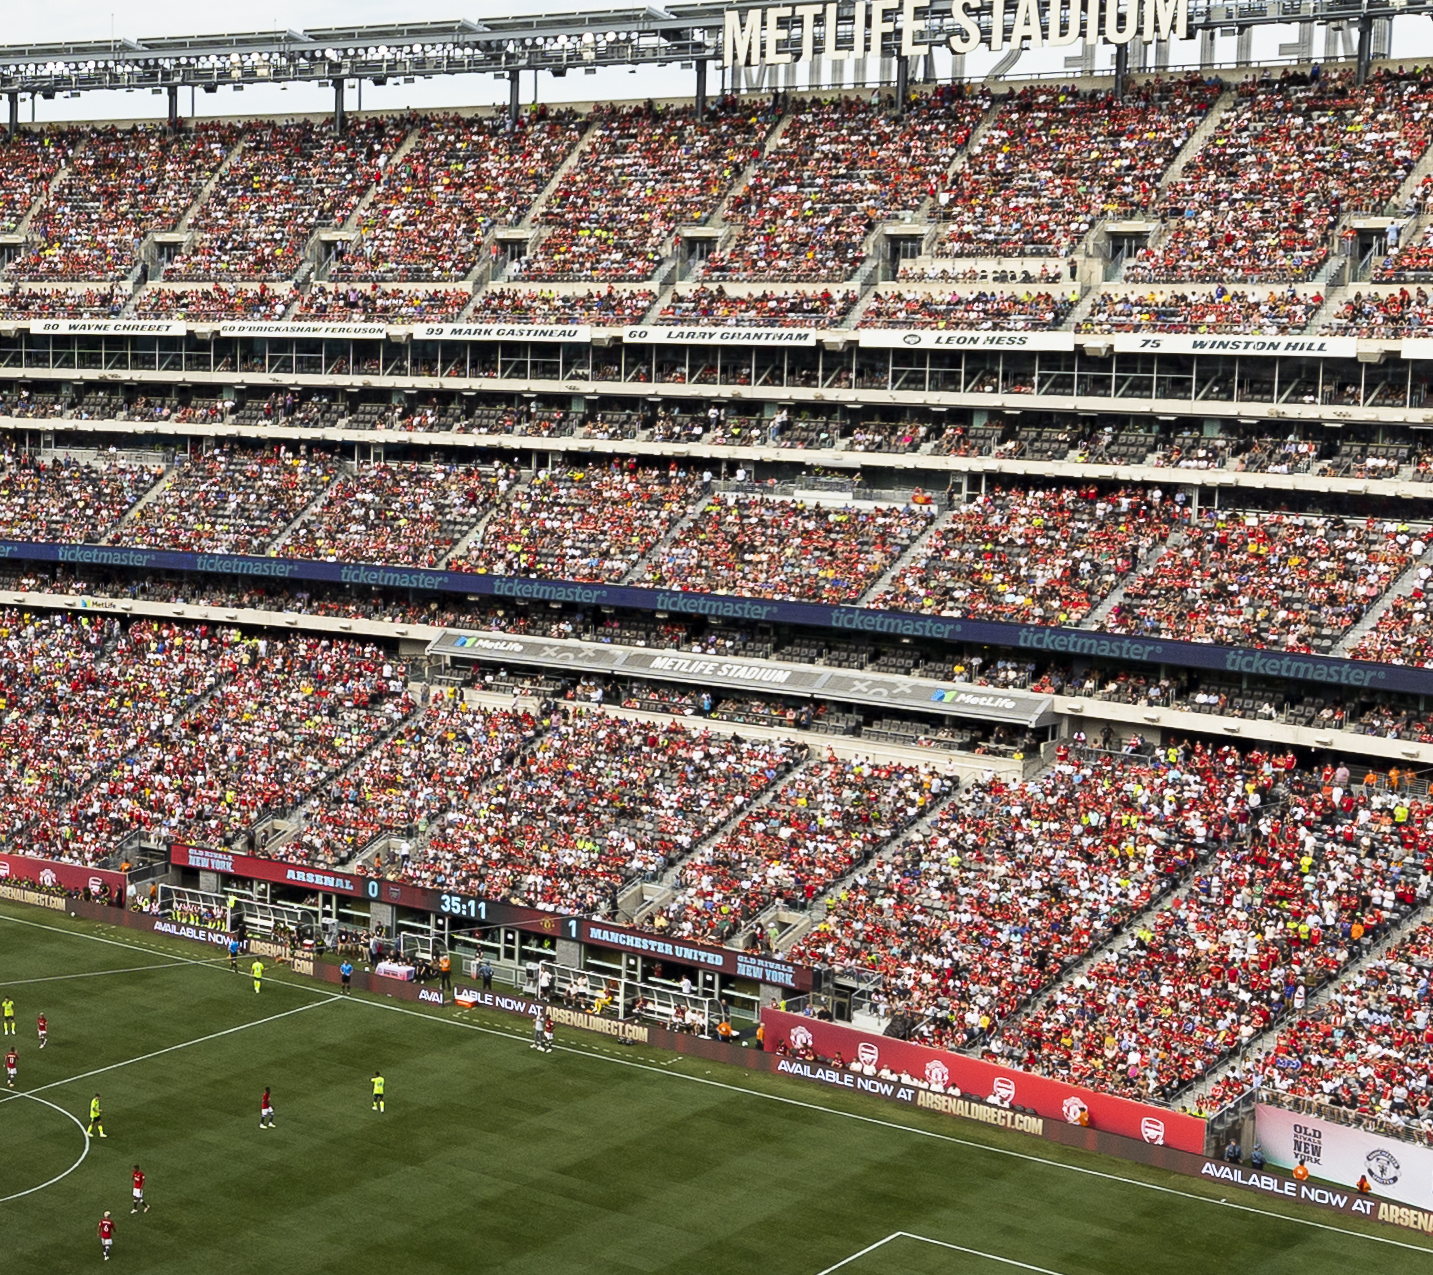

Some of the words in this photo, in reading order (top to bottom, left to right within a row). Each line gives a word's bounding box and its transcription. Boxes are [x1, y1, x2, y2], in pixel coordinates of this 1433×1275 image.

[43, 323, 60, 332] 80
[68, 324, 113, 332] WAYNE
[115, 324, 172, 333] CHREBET
[221, 326, 235, 334] 60
[324, 327, 385, 335] FERGUSON
[425, 328, 444, 336] 99
[449, 328, 493, 337] MARK
[495, 328, 578, 338] GASTINEAU
[628, 330, 649, 339] 60
[666, 331, 717, 340] LARRY
[719, 332, 810, 342] GRANTHAM
[934, 334, 981, 344] LEON
[982, 335, 1029, 345] HESS
[1138, 339, 1162, 349] 75
[1191, 340, 1281, 351] WINSTON
[1283, 341, 1329, 352] HILL
[58, 545, 151, 567] ticketmaster
[196, 554, 293, 577] ticketmaster
[340, 565, 444, 590] ticketmaster
[493, 579, 602, 604] ticketmaster
[92, 600, 117, 609] MetLife
[656, 593, 771, 619] ticketmaster
[831, 607, 955, 637] ticketmaster
[474, 638, 524, 652] MetLife
[1019, 627, 1153, 660] ticketmaster
[649, 656, 719, 675] METLIFE
[717, 662, 792, 684] STADIUM
[1225, 650, 1376, 686] ticketmaster
[955, 692, 1016, 709] MetLife
[189, 848, 203, 856] OLD
[189, 855, 209, 869] NEW
[209, 858, 235, 872] YORK.
[287, 869, 354, 891] ARSENAL
[368, 880, 378, 898] 0
[440, 893, 487, 920] 35:11
[154, 920, 206, 941] AVAILABLE
[207, 930, 234, 947] NOW
[569, 919, 576, 939] 1
[589, 927, 674, 954] MANCHESTER
[675, 946, 724, 966] UNITED
[736, 962, 764, 979] NEW
[764, 967, 796, 987] YORK.
[737, 955, 755, 964] OLD
[756, 957, 796, 973] RIVALS.
[495, 995, 526, 1013] NOW
[545, 1006, 649, 1043] ARSENALDIRECT.COM
[778, 1060, 854, 1088] AVAILABLE
[857, 1077, 894, 1096] NOW
[897, 1086, 915, 1101] AT
[917, 1090, 1043, 1136] ARSENALDIRECT.COM
[1293, 1124, 1323, 1140] OLD
[1293, 1138, 1323, 1157] NEW
[1202, 1162, 1297, 1197] AVAILABLE
[1301, 1185, 1348, 1210] NOW
[1351, 1198, 1374, 1216] AT
